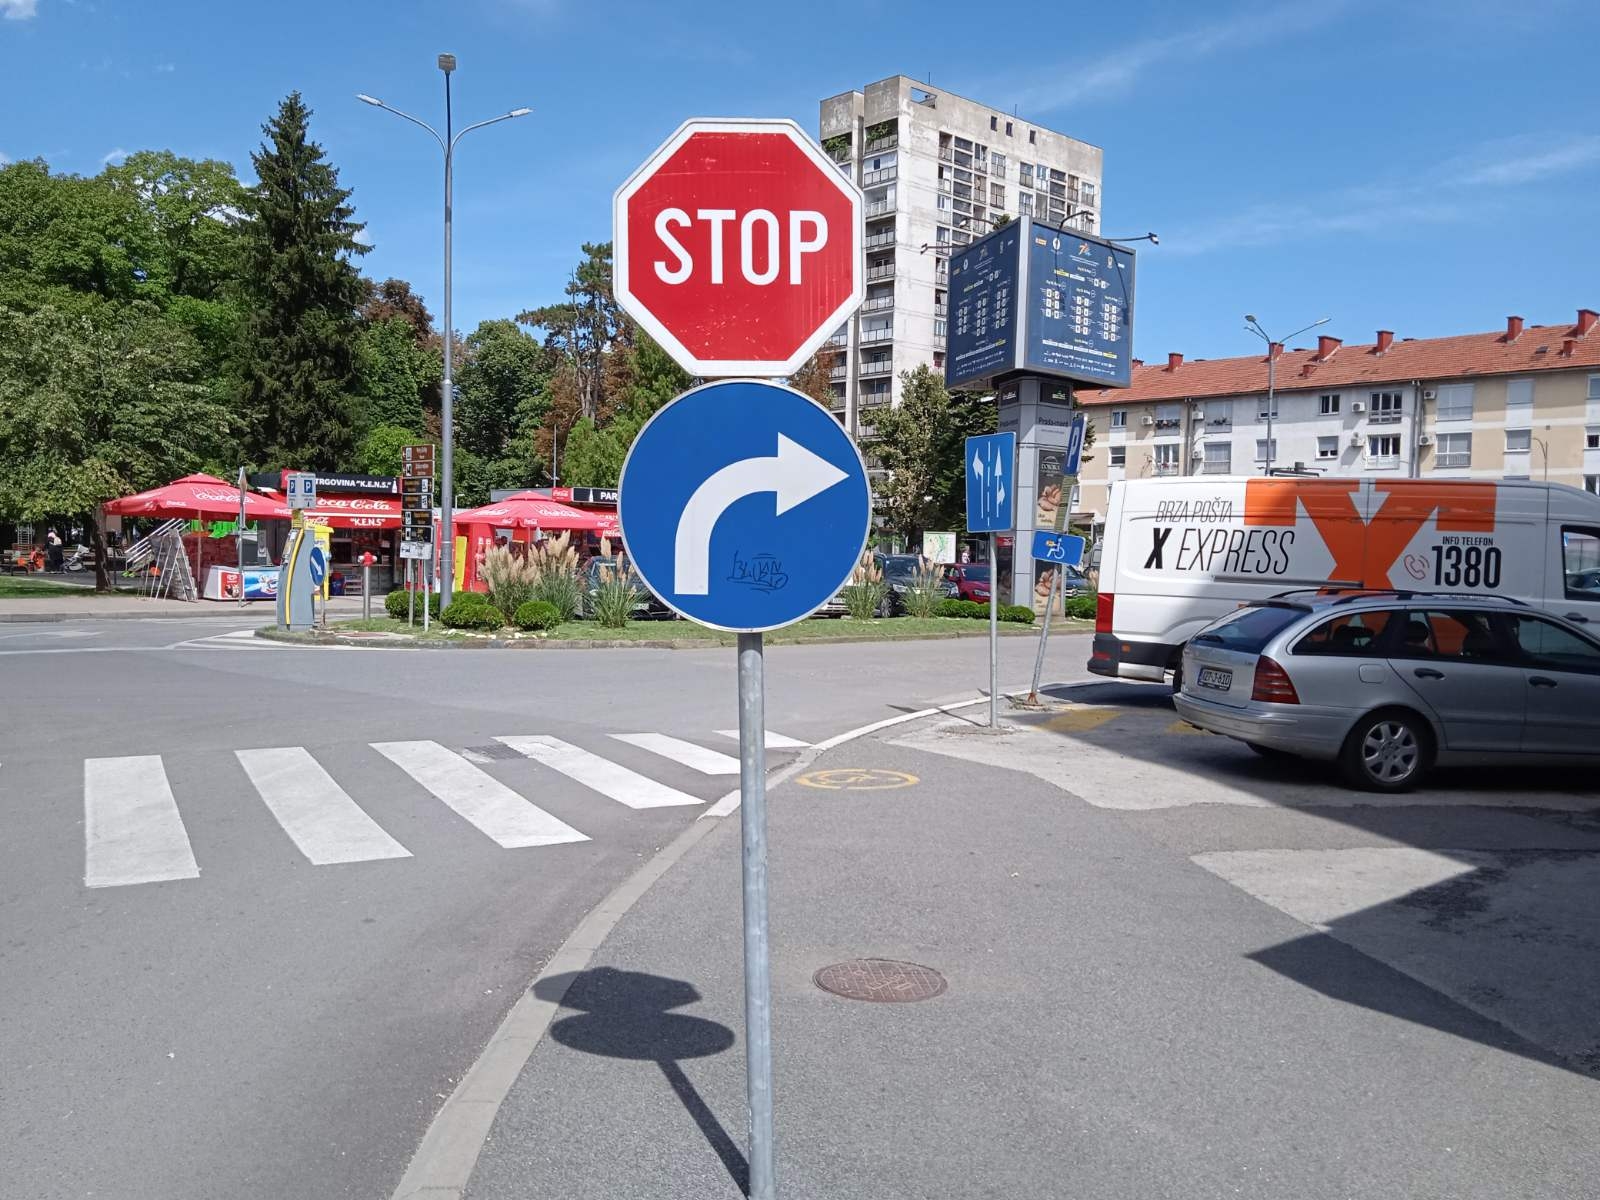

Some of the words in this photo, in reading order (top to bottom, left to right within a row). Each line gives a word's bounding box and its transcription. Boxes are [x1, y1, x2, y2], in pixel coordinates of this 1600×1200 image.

[654, 207, 829, 286] STOP
[1067, 427, 1080, 468] P
[316, 478, 355, 487] TRGOVINA
[316, 498, 393, 512] oca-Cola
[1155, 500, 1188, 523] BRZA
[1191, 496, 1232, 523] POŠTA
[1144, 527, 1172, 569] X
[1176, 528, 1295, 575] EXPRESS
[1442, 536, 1460, 546] INFO
[1462, 536, 1494, 546] TELEFON
[1431, 545, 1502, 589] 1380
